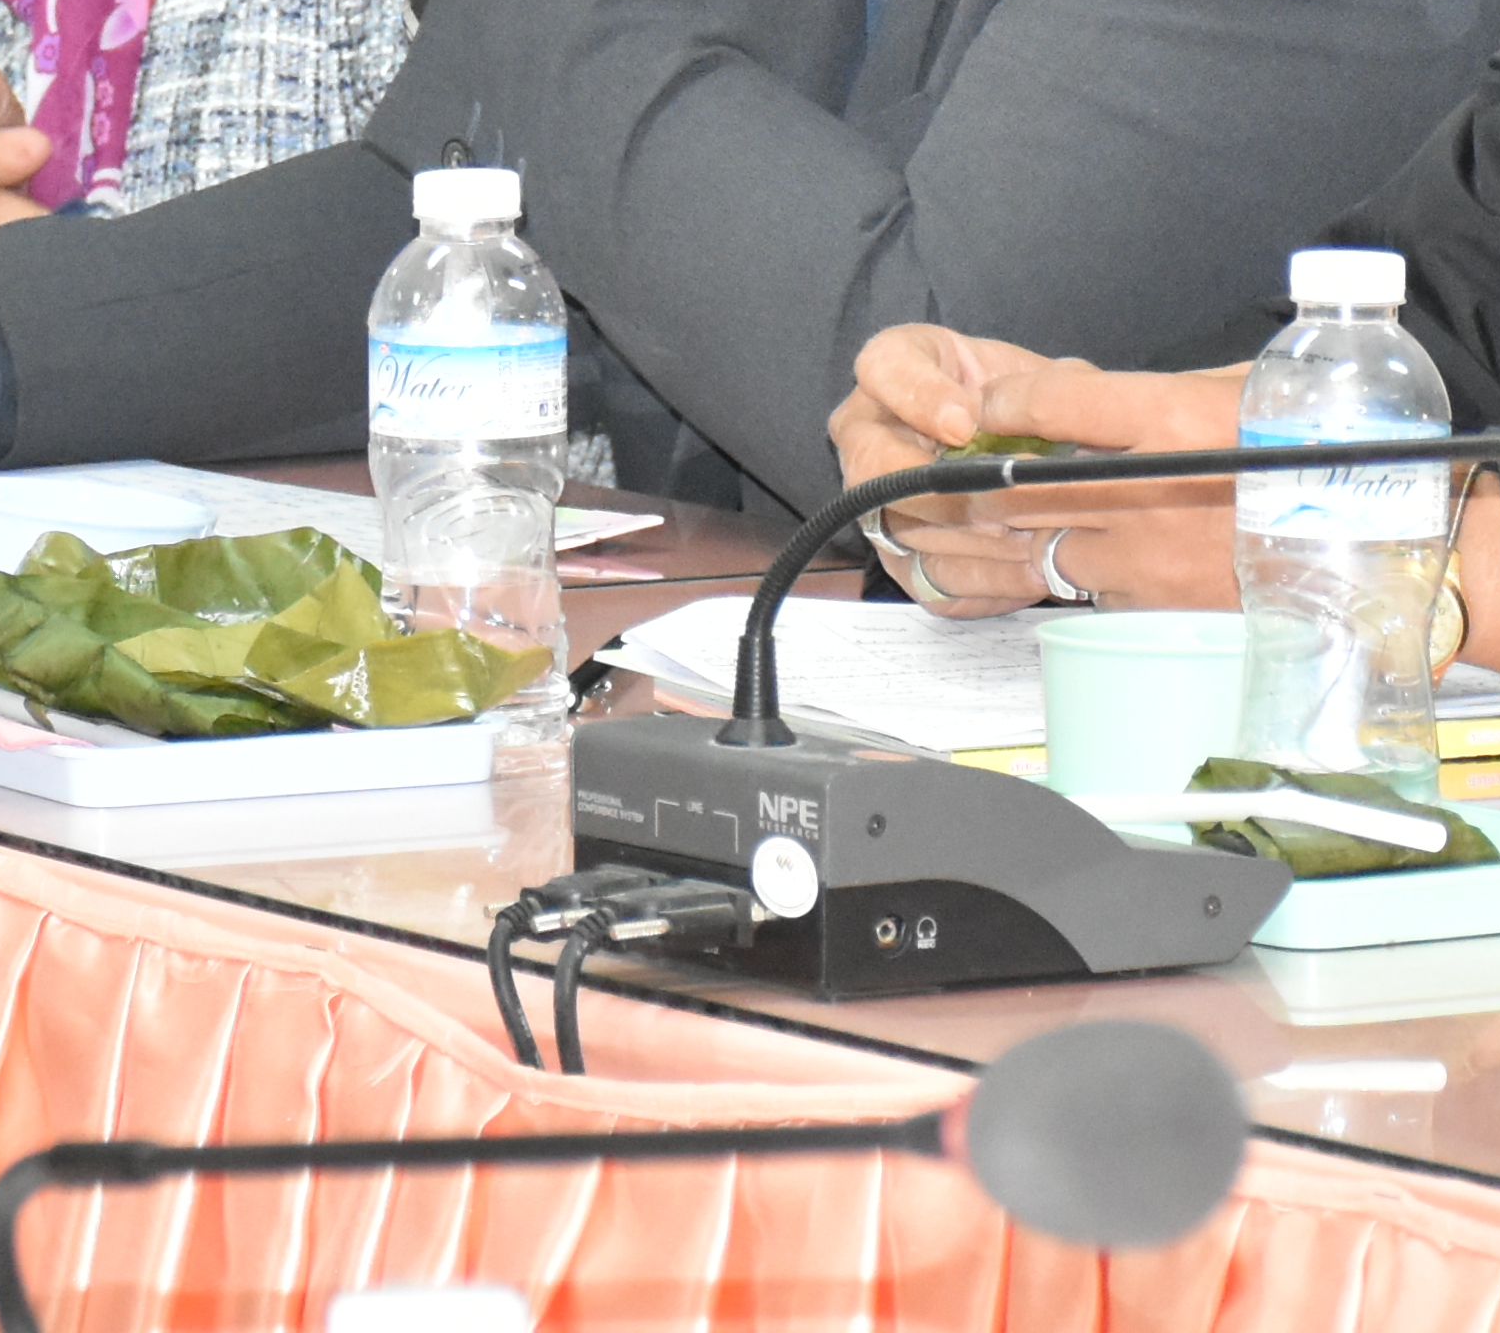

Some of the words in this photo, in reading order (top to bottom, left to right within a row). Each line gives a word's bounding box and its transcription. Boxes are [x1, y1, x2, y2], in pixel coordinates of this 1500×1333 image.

[377, 352, 473, 401] Water
[1298, 465, 1416, 499] Water
[759, 791, 819, 830] NPE
